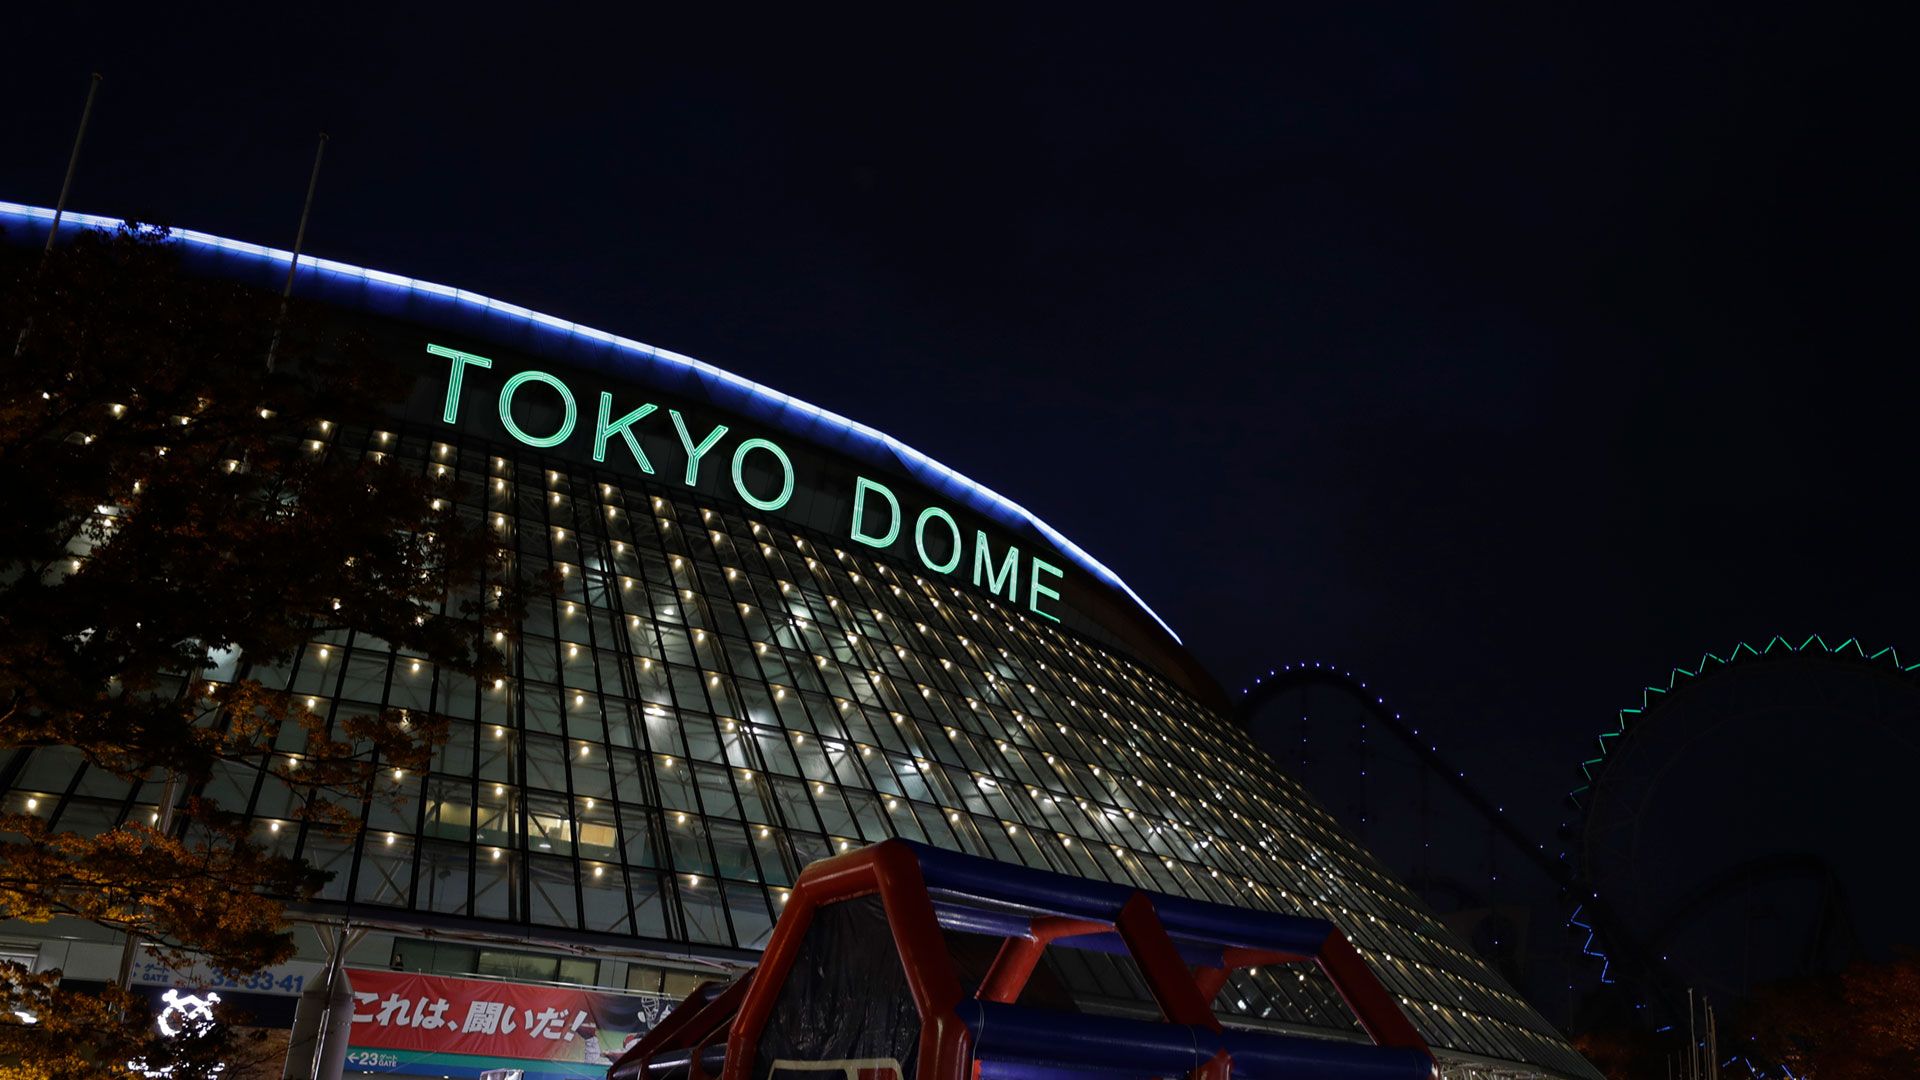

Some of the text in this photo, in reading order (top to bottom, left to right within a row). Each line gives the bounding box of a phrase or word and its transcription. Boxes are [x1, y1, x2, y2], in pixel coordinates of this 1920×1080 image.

[426, 343, 1064, 623] TOKYO DOME
[143, 973, 169, 983] GATE
[358, 1052, 379, 1066] 23
[378, 1059, 397, 1067] GATE
